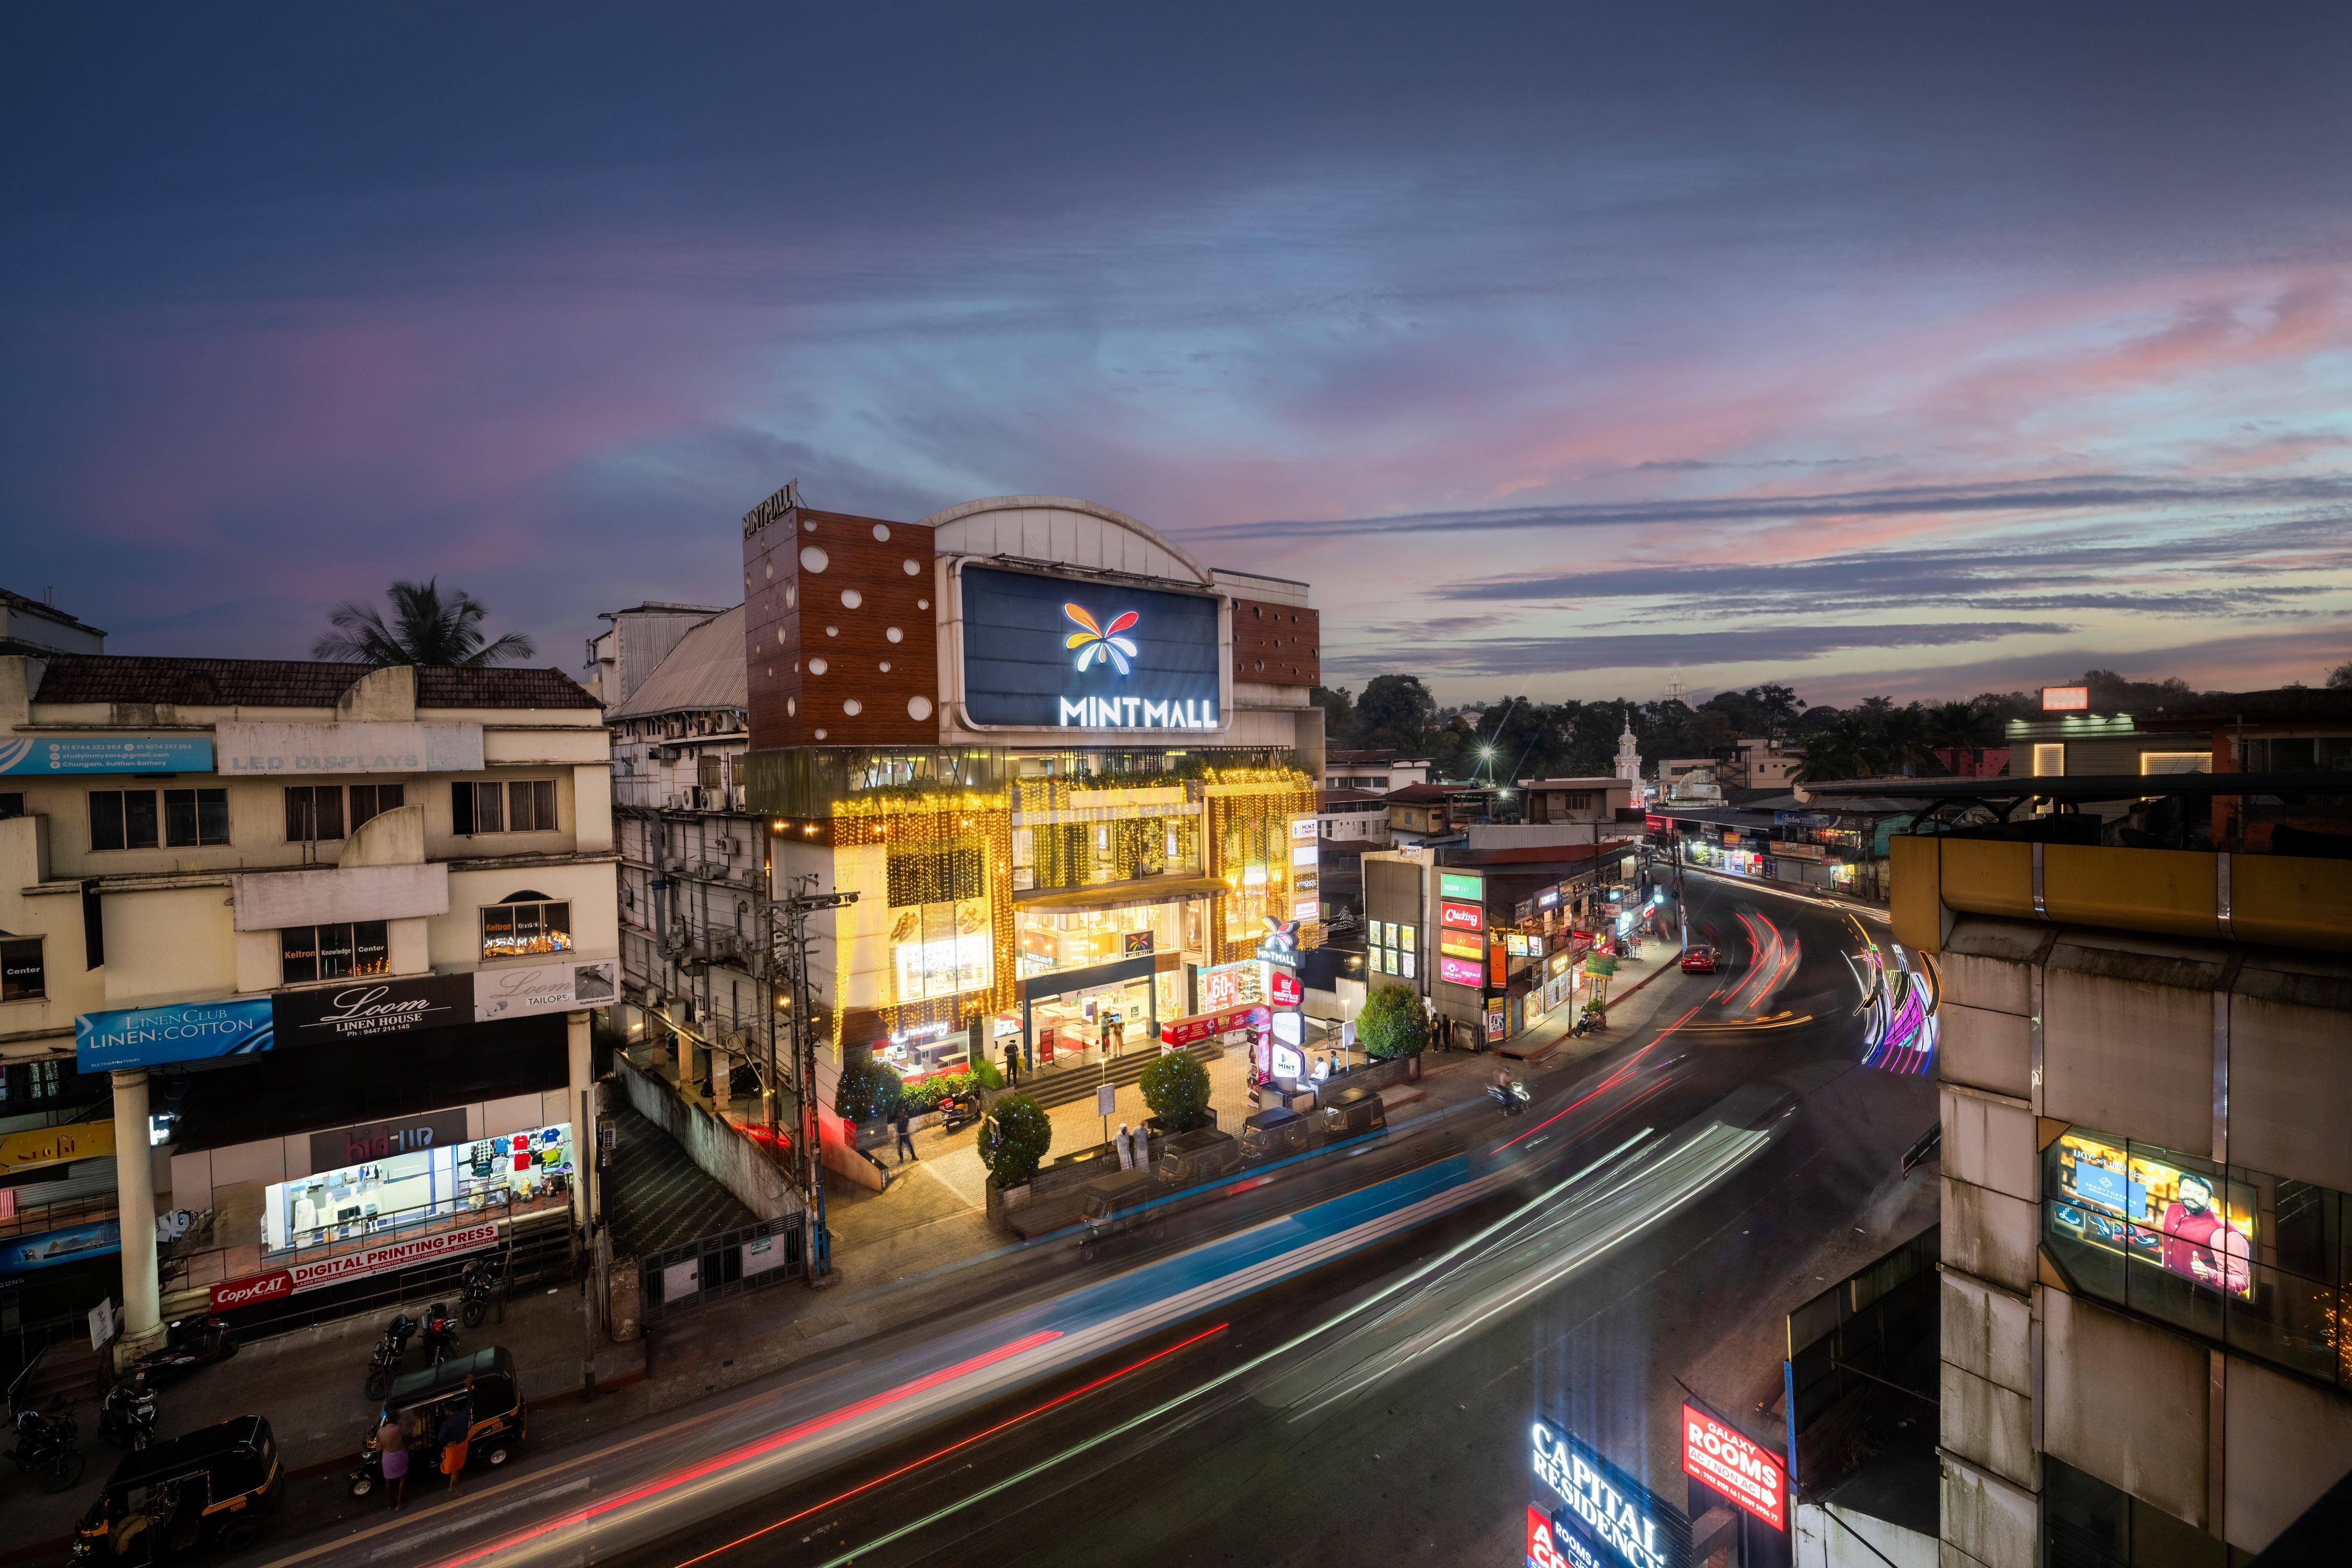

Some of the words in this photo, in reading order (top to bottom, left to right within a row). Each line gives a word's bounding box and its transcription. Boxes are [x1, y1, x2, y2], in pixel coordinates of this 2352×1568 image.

[743, 485, 793, 538] MINTMALL
[1060, 696, 1217, 728] MINTMALL
[232, 756, 284, 770] LED
[295, 754, 418, 769] DISPLAYS
[1446, 908, 1477, 926] Chicking
[285, 950, 316, 960] Keltron
[321, 948, 351, 956] Knowledge
[490, 971, 573, 998] Loom
[320, 986, 430, 1021] Loom
[336, 1019, 375, 1032] LINEN
[379, 1013, 422, 1027] HOUSE
[1275, 1022, 1299, 1032] TRENDS
[1278, 1063, 1295, 1072] MINT
[296, 1256, 363, 1281] DIGITAL
[367, 1238, 444, 1264] PRINTING
[448, 1226, 494, 1245] PRESS
[372, 1260, 402, 1270] MEMENTOS,
[466, 1238, 494, 1247] PHOTOSTAT
[217, 1276, 286, 1303] CopyCAT
[1707, 1422, 1756, 1455] GALAXY
[1689, 1422, 1777, 1489] ROOMS
[1690, 1448, 1704, 1465] AC
[1714, 1462, 1739, 1484] NON
[1742, 1477, 1756, 1494] AC
[1533, 1423, 1666, 1566] CAPITAL
[1689, 1463, 1700, 1476] Mob
[1703, 1471, 1715, 1485] 7902
[1730, 1486, 1737, 1496] 46
[1757, 1503, 1770, 1518] 5906
[1771, 1511, 1778, 1522] 77
[1555, 1521, 1592, 1566] ROOMS
